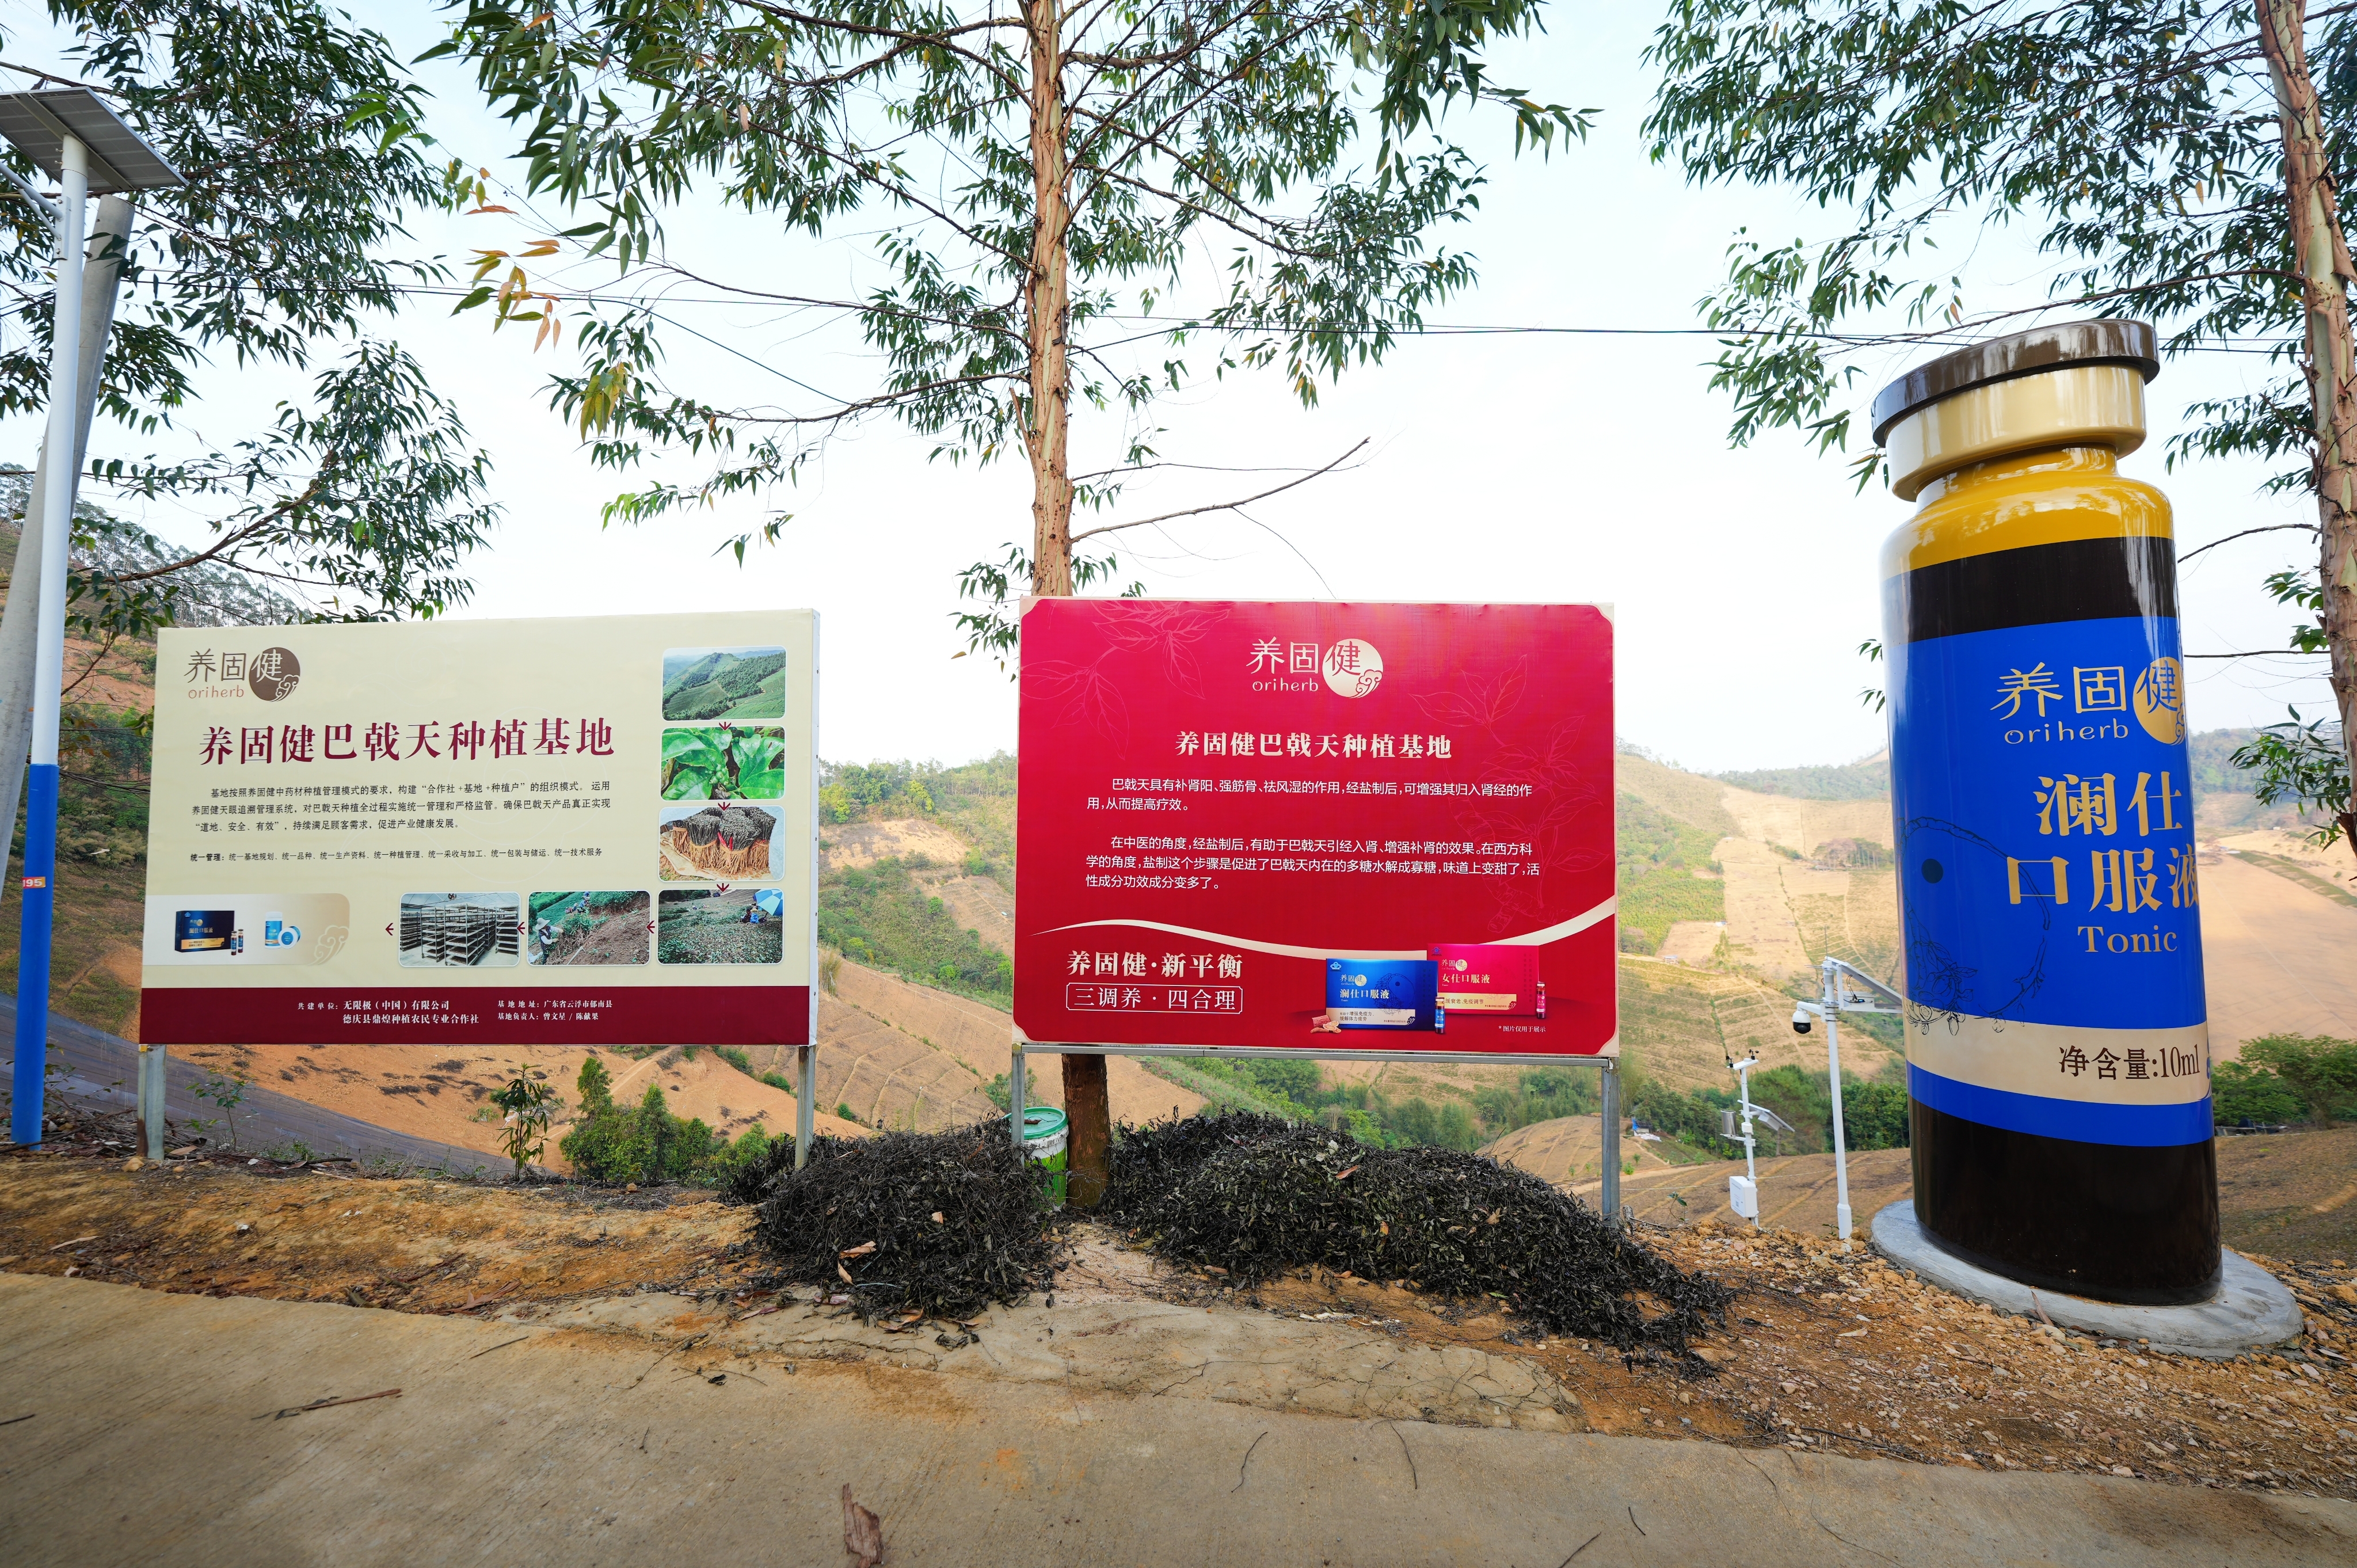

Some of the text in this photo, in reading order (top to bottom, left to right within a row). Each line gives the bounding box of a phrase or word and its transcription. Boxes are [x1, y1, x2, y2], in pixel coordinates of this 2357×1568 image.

[184, 648, 283, 683] 养固健
[1246, 636, 1361, 676] 养固健
[188, 685, 244, 699] oriherb
[1252, 677, 1319, 692] oriherb
[1990, 660, 2179, 721] 养固健
[2004, 718, 2129, 744] oriherb
[199, 717, 614, 766] 养固健巴戟天种植基地
[1175, 730, 1452, 759] 养固健巴戟天种植基地
[1087, 797, 1189, 811] 用，从而提高疗效。
[2033, 771, 2182, 837] 澜仕
[1086, 874, 1219, 889] 性成分功效成分变多了。
[2077, 924, 2177, 953] Tonic
[1441, 958, 1463, 967] 养固健
[1340, 974, 1363, 983] 养固健
[1441, 973, 1491, 984] 女仕口服液
[1340, 989, 1389, 999] 澜仕口服液
